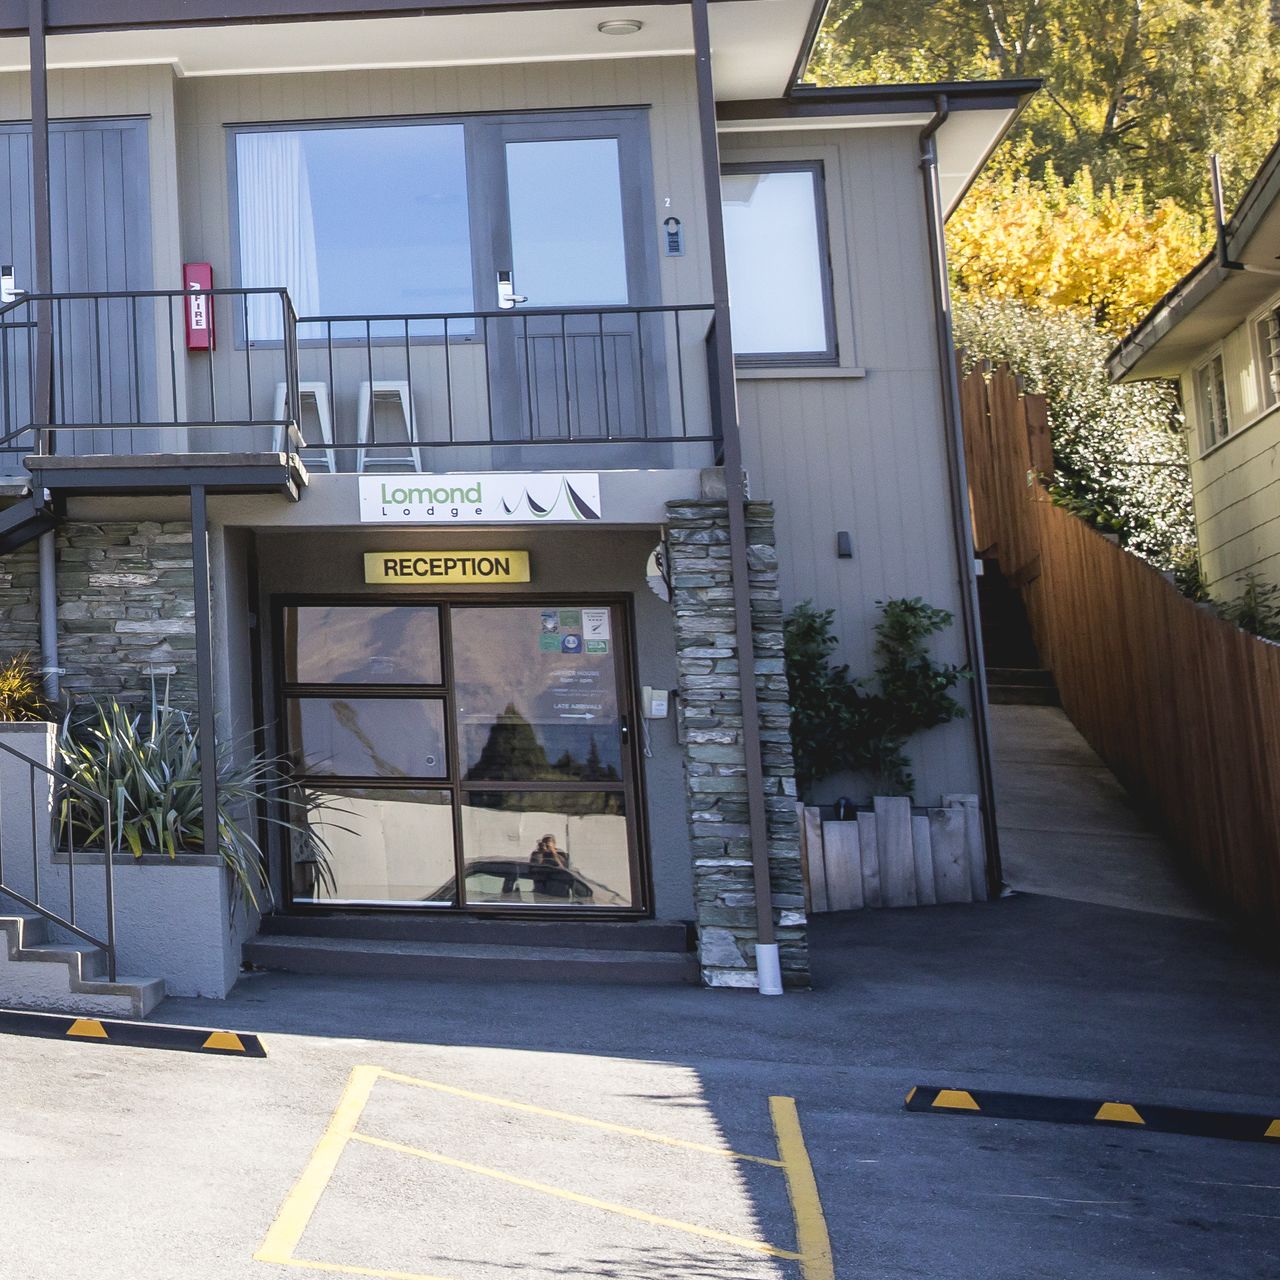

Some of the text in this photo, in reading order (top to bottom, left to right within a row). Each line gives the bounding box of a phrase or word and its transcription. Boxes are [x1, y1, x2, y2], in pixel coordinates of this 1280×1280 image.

[664, 197, 671, 207] 2
[194, 294, 203, 327] FIRE
[381, 482, 482, 505] Lomond
[382, 506, 482, 517] Lodge
[383, 557, 510, 577] RECEPTION
